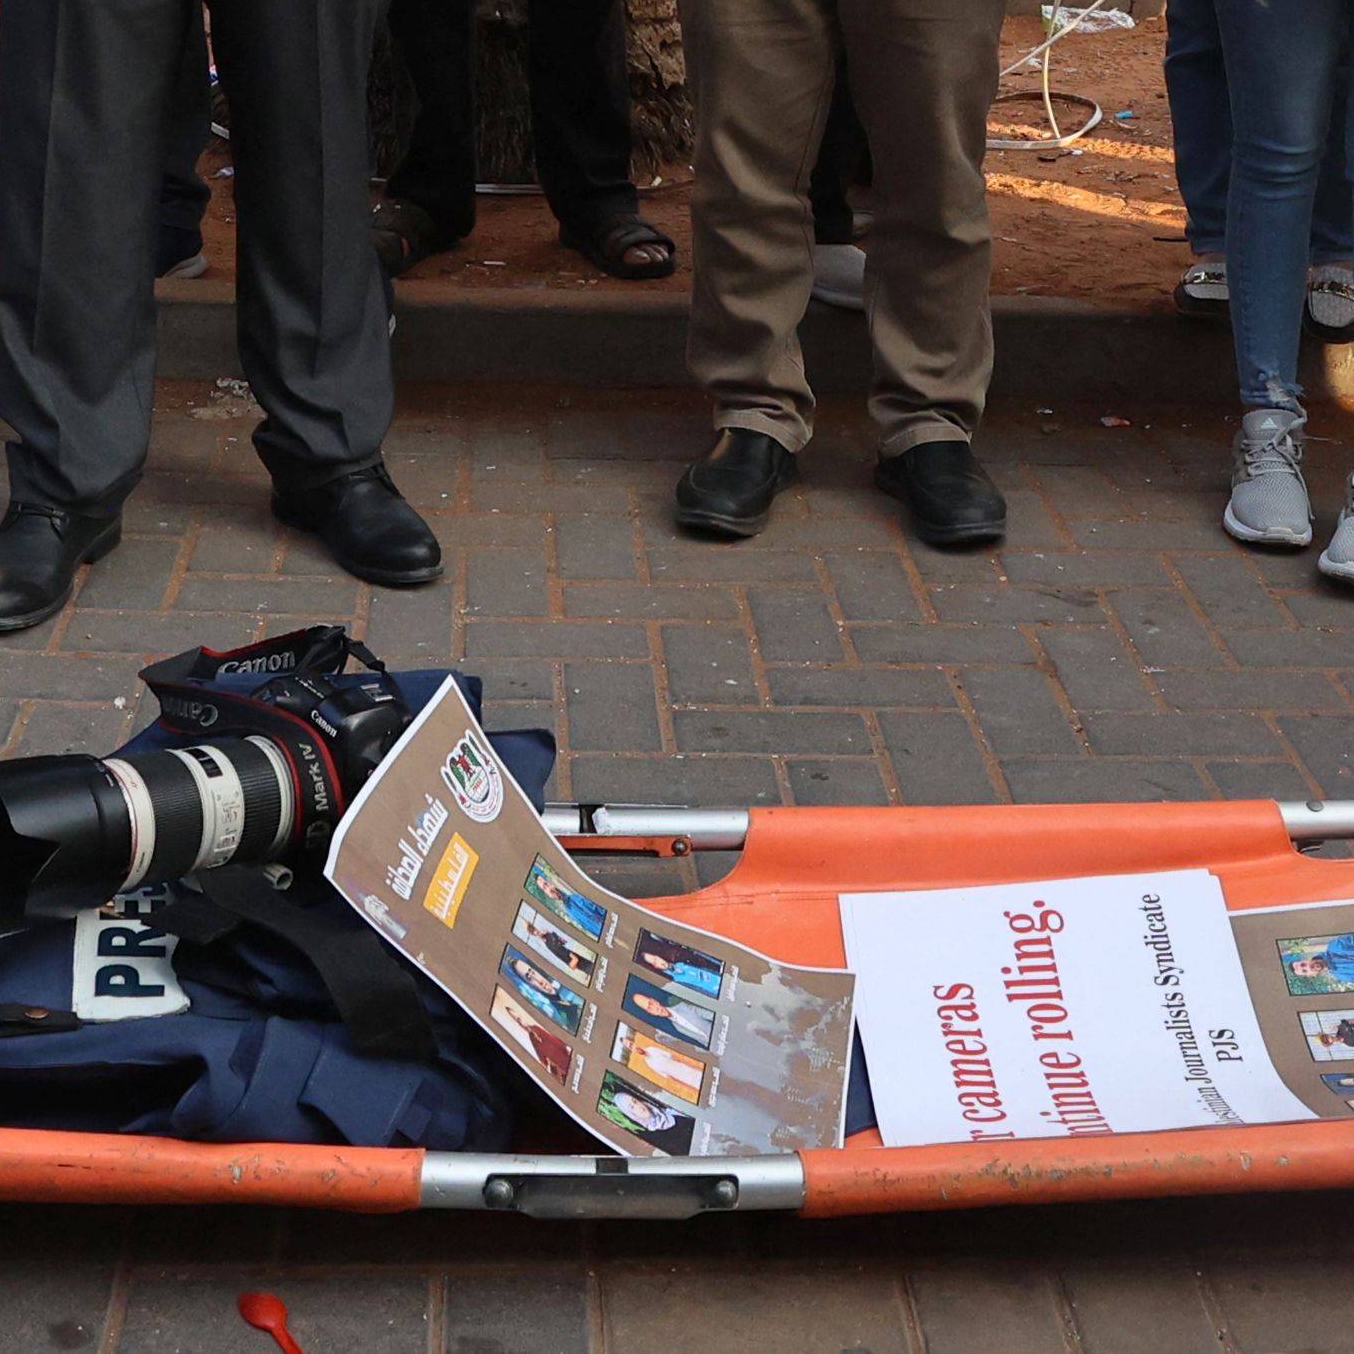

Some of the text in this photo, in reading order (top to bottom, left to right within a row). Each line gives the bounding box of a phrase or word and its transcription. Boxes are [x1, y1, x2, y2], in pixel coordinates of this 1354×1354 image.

[217, 650, 296, 674] Canon
[299, 742, 317, 761] IV
[310, 709, 338, 739] Canon
[308, 761, 330, 812] Mark
[408, 793, 448, 857] شهداء
[1137, 893, 1185, 988] Syndicate
[1002, 899, 1074, 1042] rolling.
[932, 982, 1008, 1125] cameras
[1155, 990, 1212, 1085] Journalists
[1208, 1027, 1244, 1064] PJS
